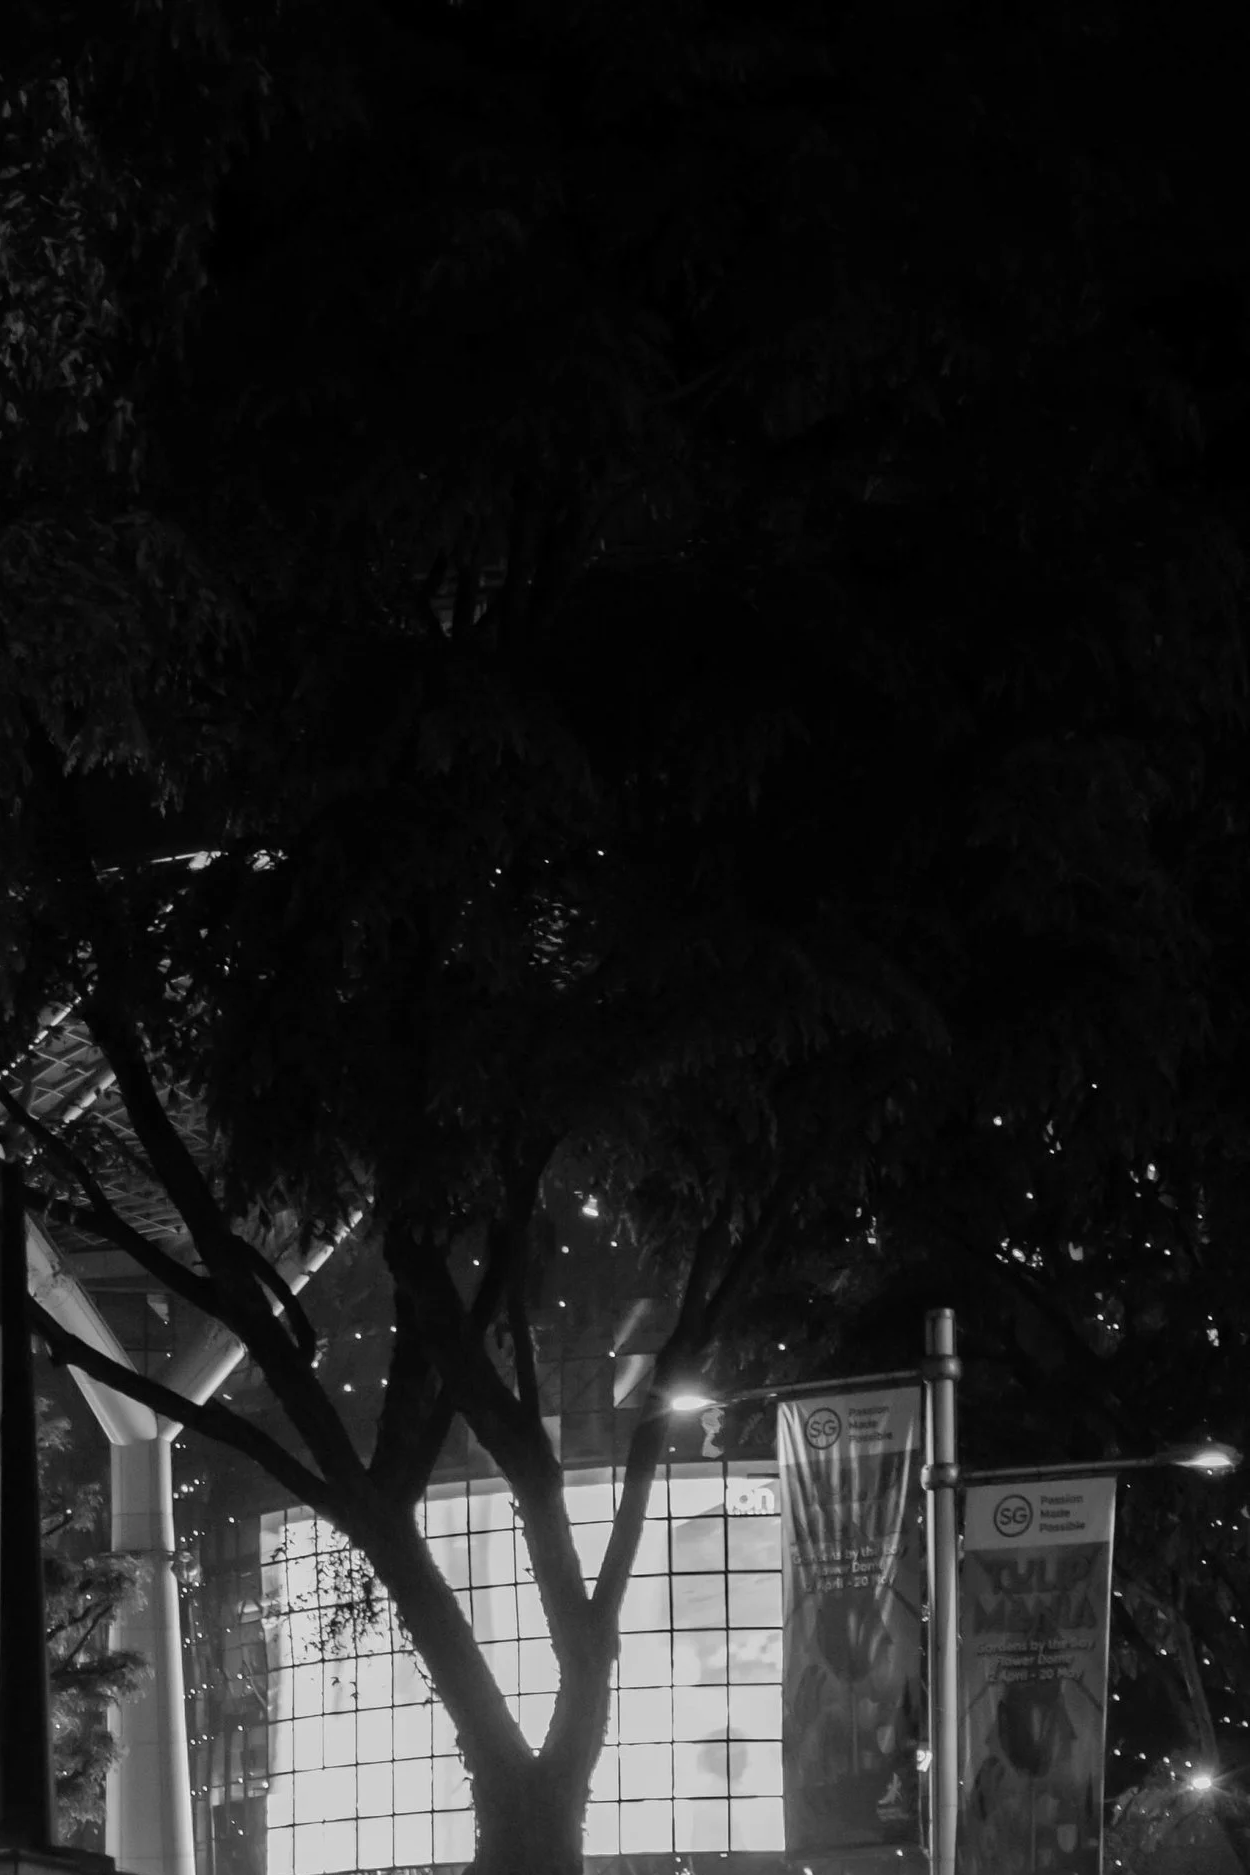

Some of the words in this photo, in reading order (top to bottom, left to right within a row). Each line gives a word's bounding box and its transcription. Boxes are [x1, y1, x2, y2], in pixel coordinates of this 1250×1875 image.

[810, 1420, 837, 1438] SG
[1040, 1495, 1084, 1505] Passion
[1000, 1507, 1028, 1525] SG
[1040, 1509, 1071, 1519] Made
[1039, 1521, 1086, 1533] Possible
